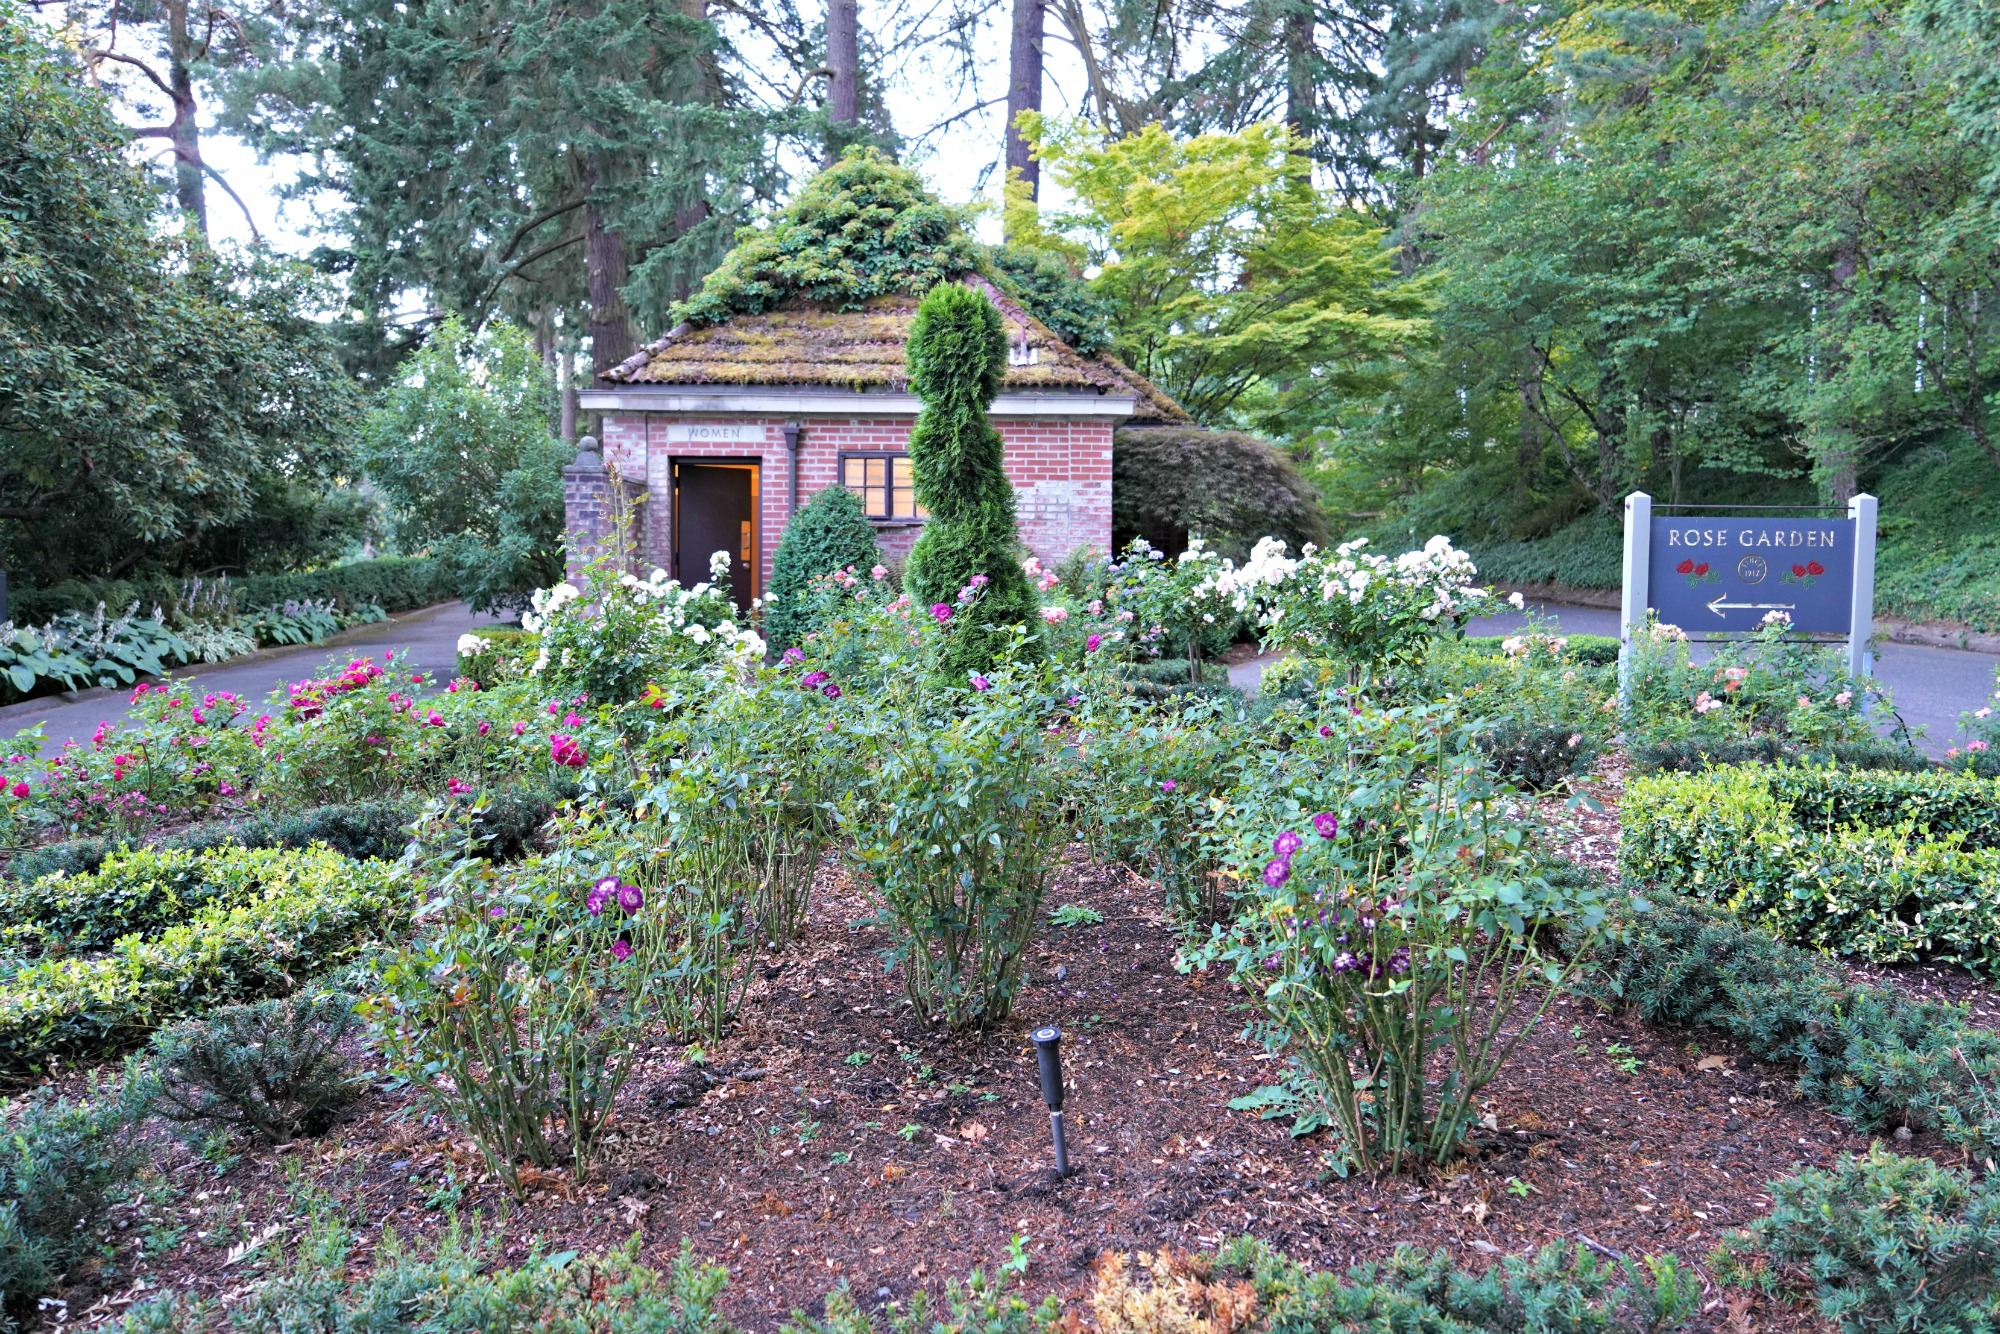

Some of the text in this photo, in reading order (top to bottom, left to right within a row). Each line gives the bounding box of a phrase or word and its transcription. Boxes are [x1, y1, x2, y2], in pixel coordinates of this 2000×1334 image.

[688, 427, 740, 439] WOMEN
[1669, 529, 1834, 547] ROSE GARDEN
[1744, 569, 1760, 577] 1917
